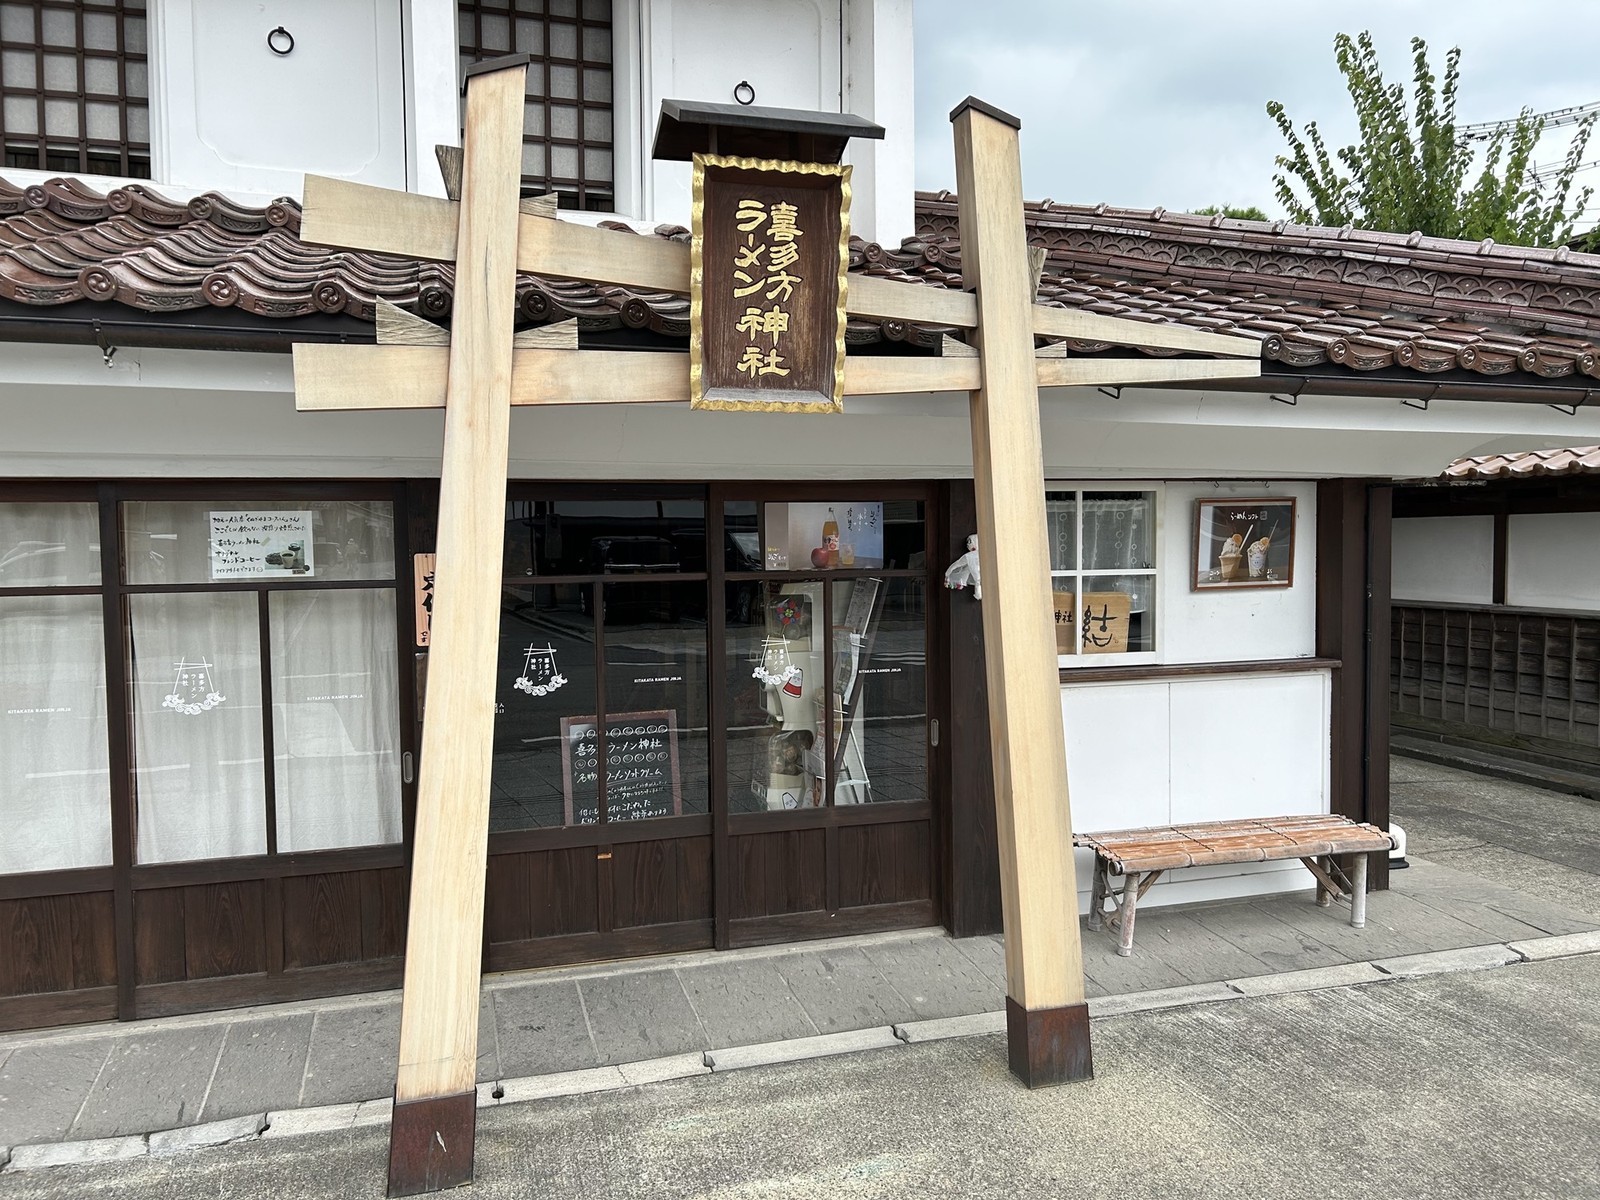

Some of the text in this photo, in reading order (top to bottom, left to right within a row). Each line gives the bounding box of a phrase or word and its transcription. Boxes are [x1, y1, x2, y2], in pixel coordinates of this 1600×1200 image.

[733, 200, 768, 298] ラーメン
[767, 201, 803, 302] 喜多方
[735, 304, 791, 378] 神社
